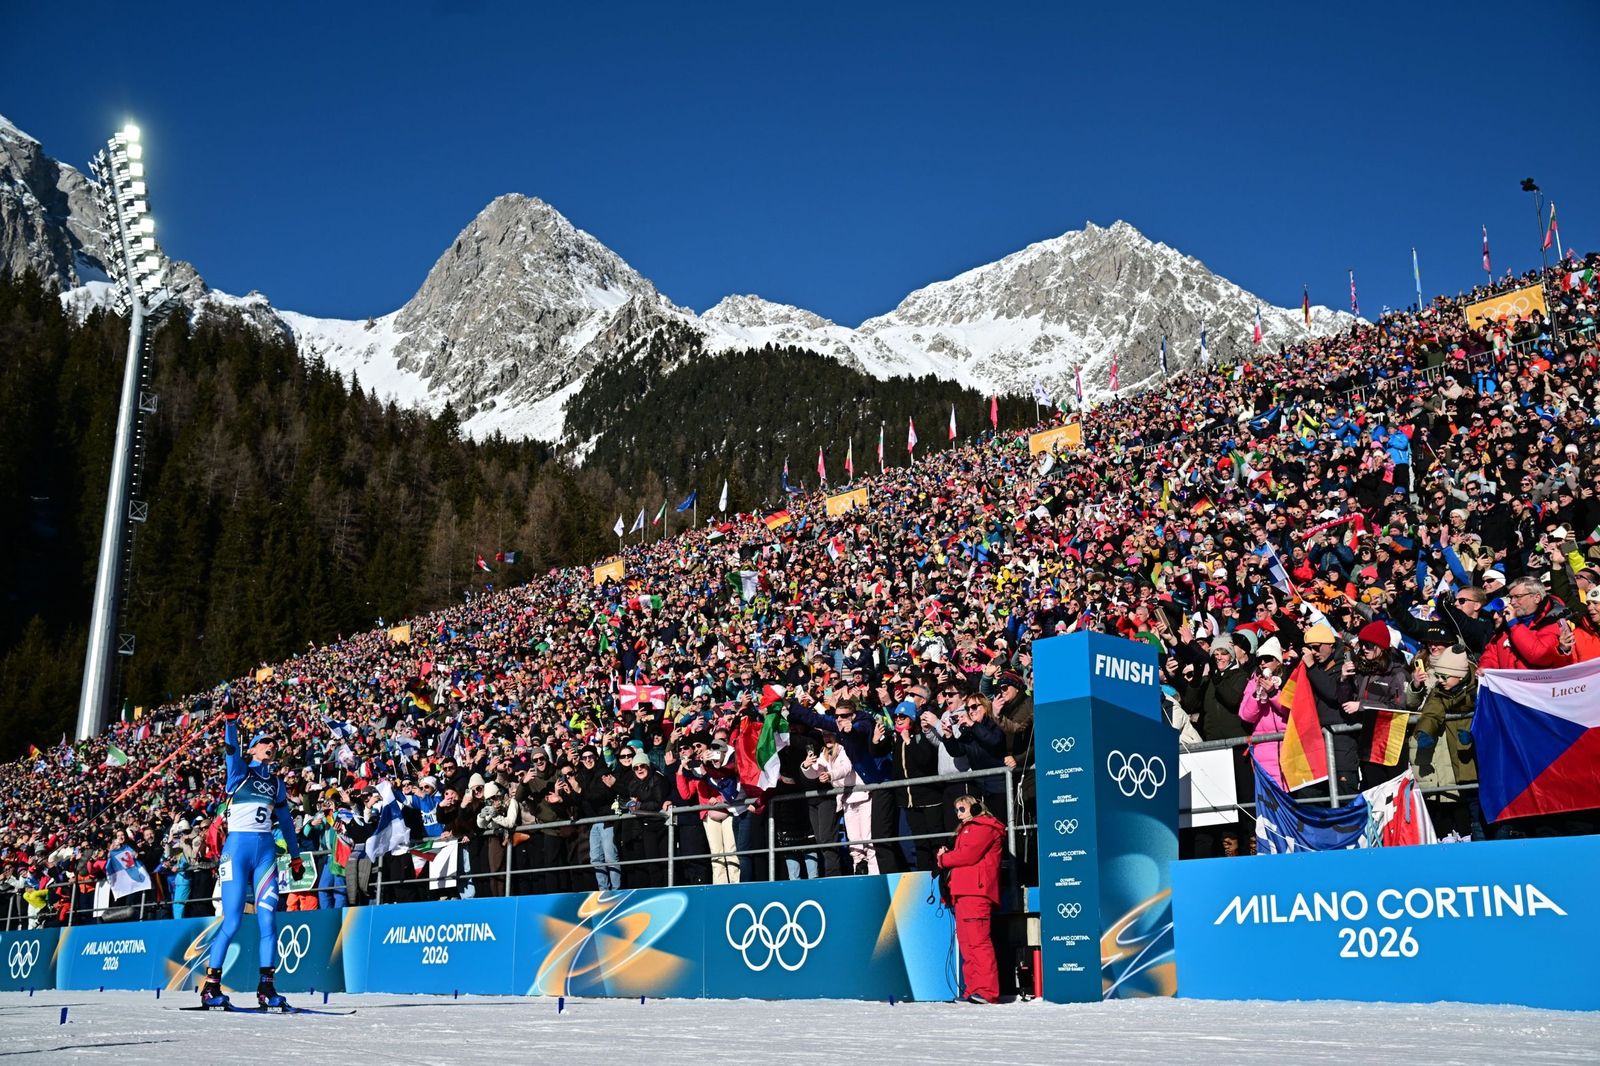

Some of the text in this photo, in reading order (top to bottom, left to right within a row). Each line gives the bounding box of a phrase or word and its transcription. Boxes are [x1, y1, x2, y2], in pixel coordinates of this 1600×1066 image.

[1095, 654, 1154, 686] FINISH
[1551, 684, 1587, 698] Lucce
[255, 806, 268, 824] 5
[220, 867, 226, 877] 5
[1213, 883, 1569, 925] MILANO CORTINA
[382, 922, 497, 945] MILANO CORTINA
[1337, 926, 1420, 959] 2026
[81, 939, 147, 956] MILANO CORTINA
[422, 945, 449, 964] 2026
[102, 956, 119, 971] 2026
